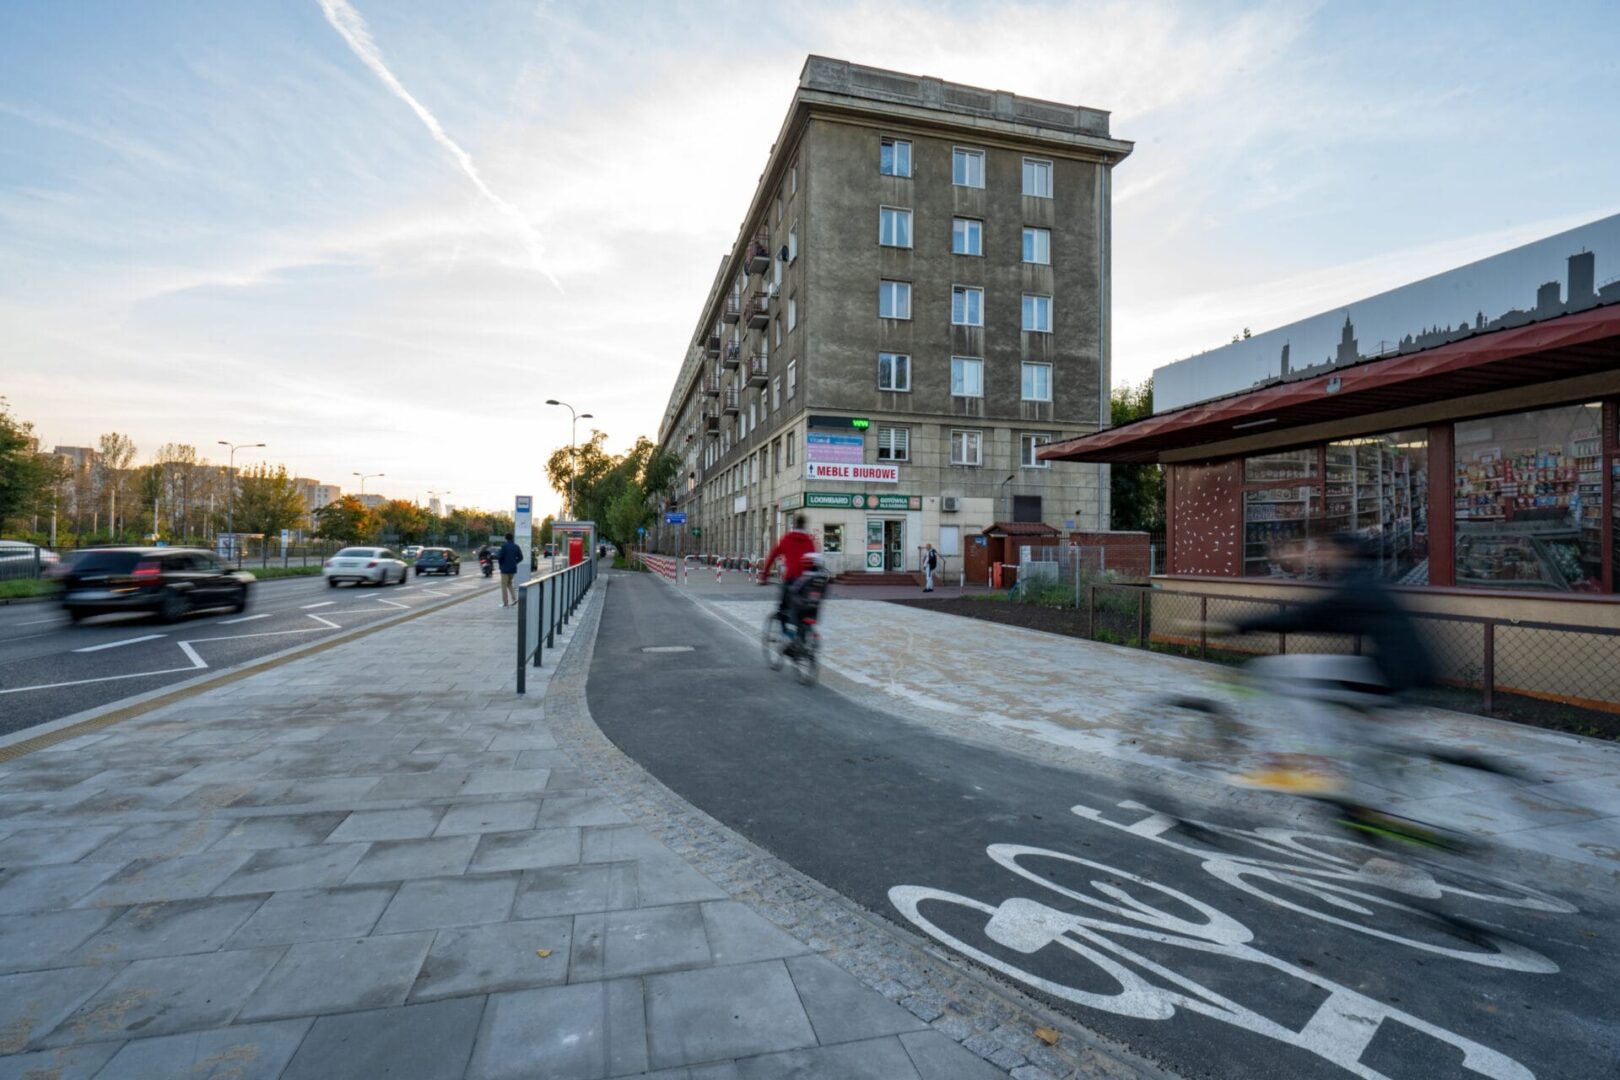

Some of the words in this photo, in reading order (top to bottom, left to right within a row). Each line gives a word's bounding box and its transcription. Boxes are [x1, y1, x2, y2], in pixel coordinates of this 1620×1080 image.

[816, 465, 850, 477] MEBLE
[852, 467, 896, 479] BIUROWE
[810, 496, 849, 504] LOOMBARD
